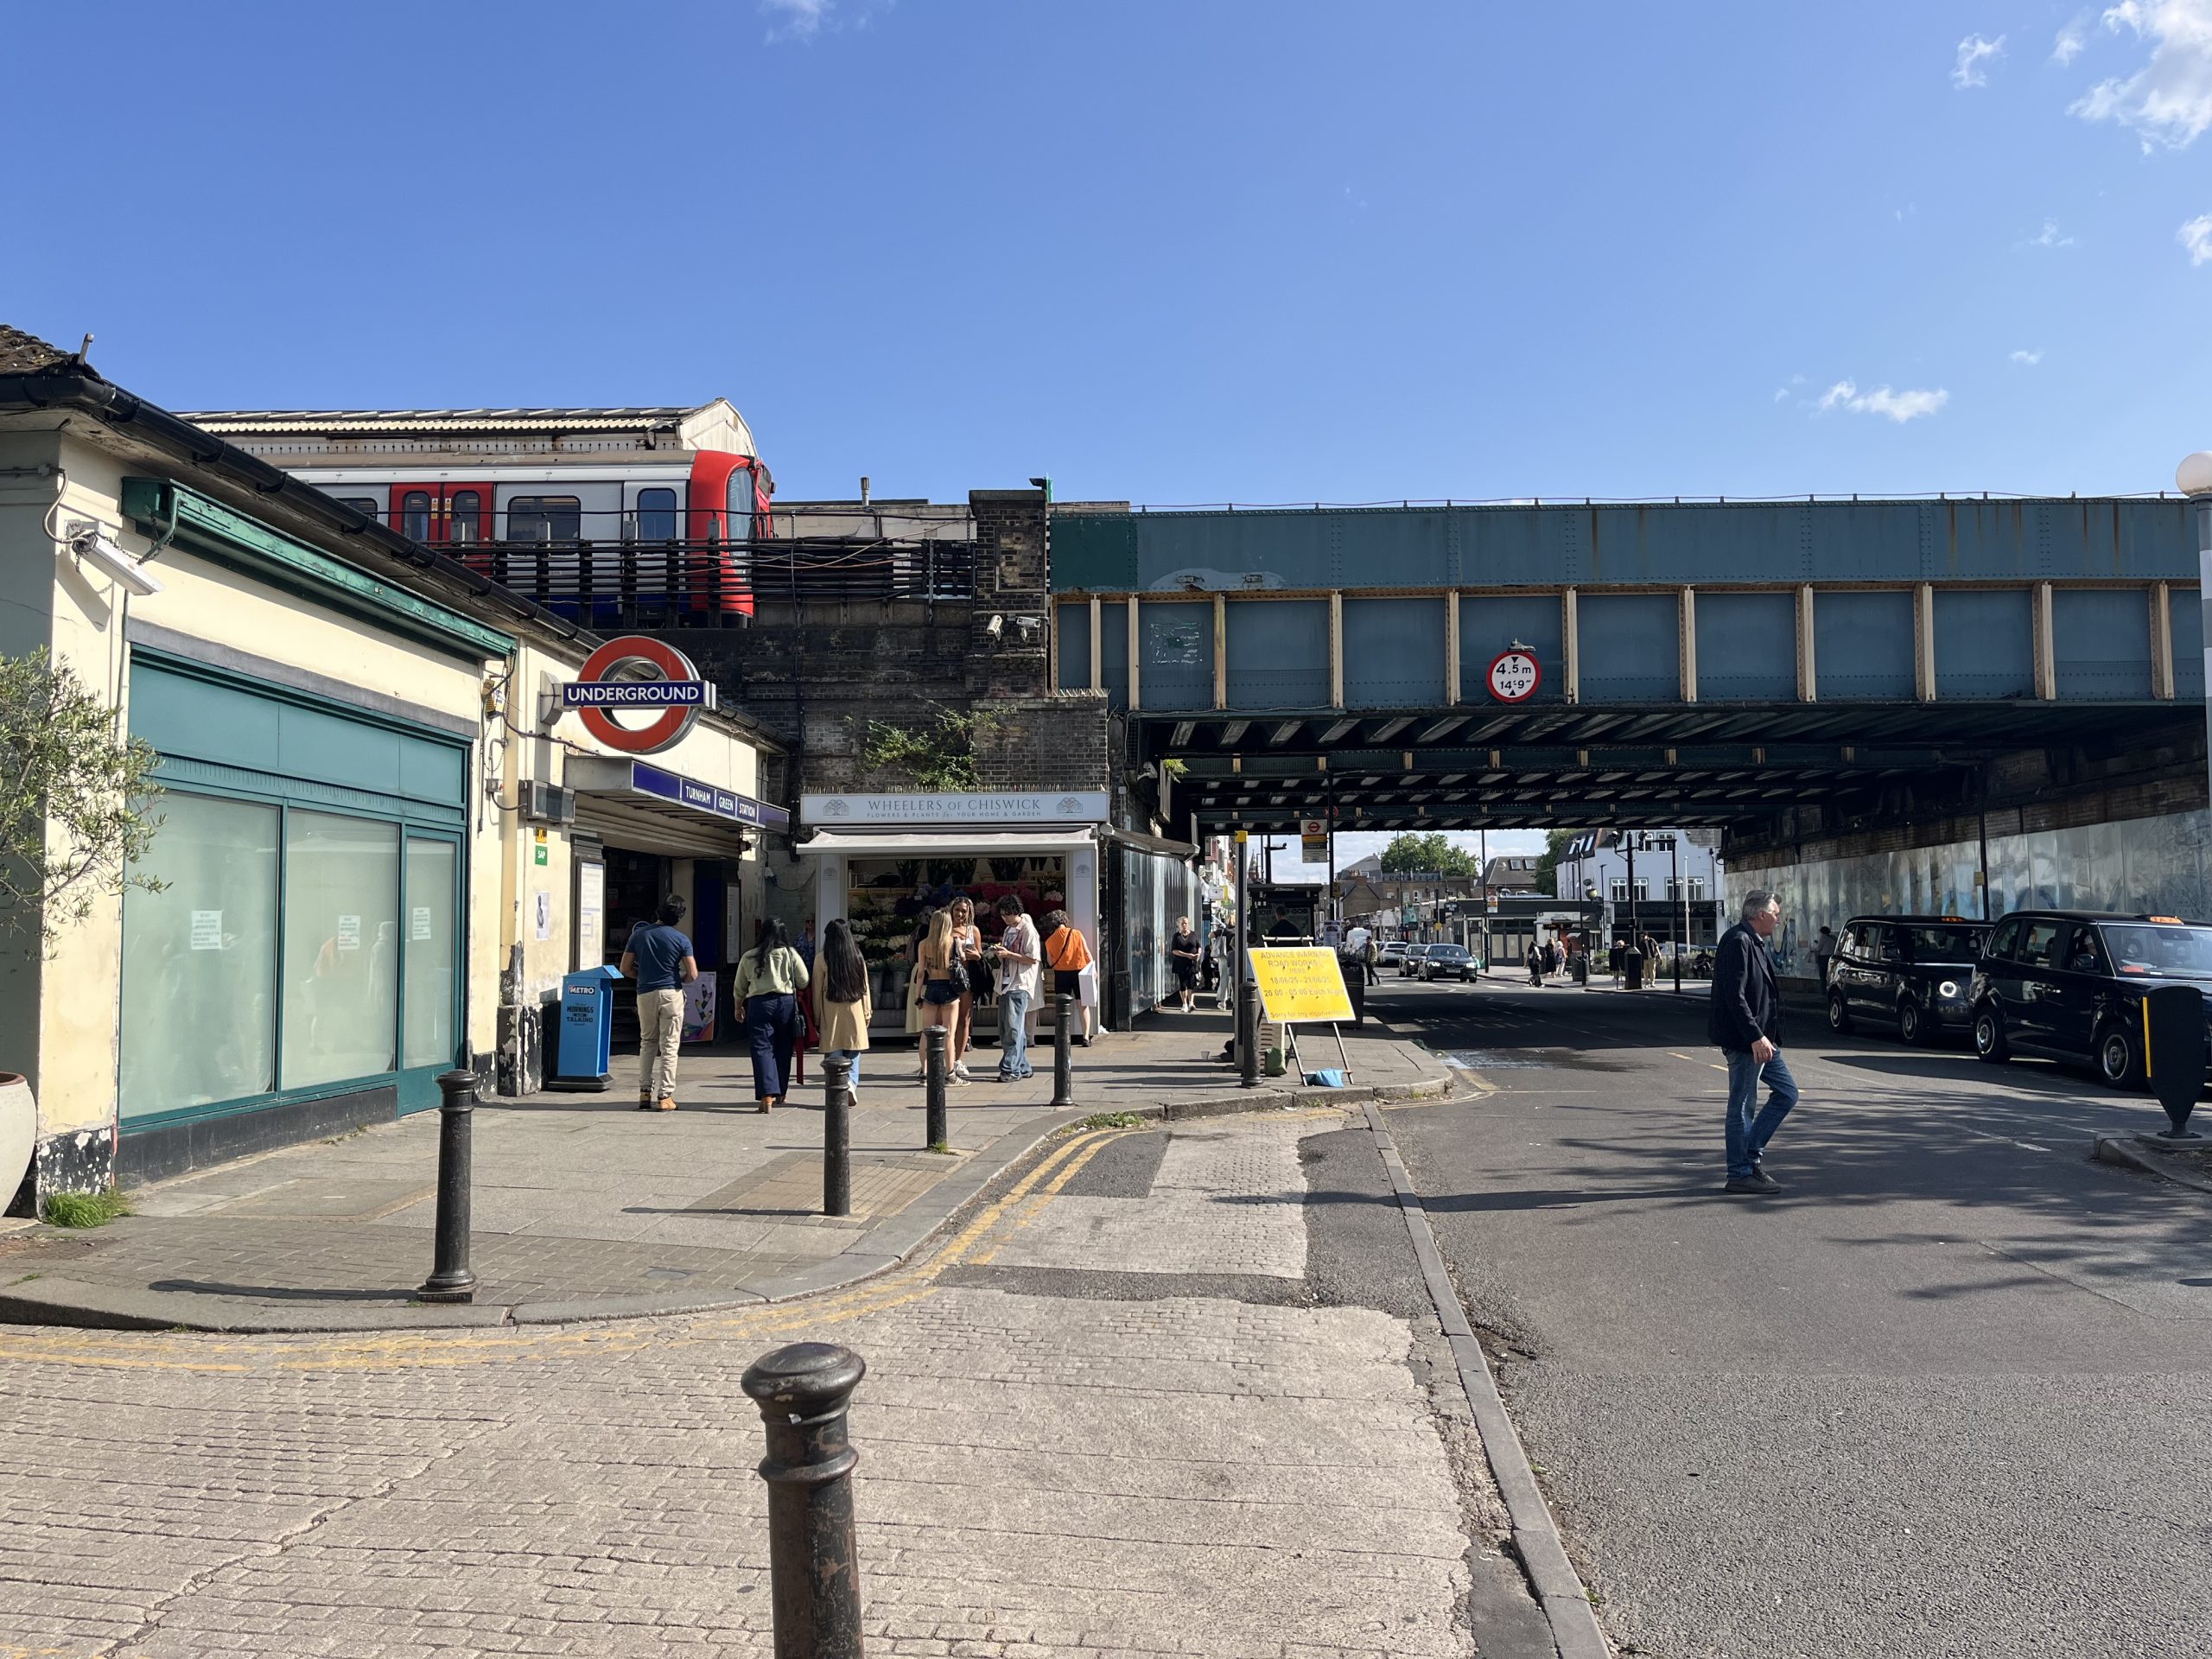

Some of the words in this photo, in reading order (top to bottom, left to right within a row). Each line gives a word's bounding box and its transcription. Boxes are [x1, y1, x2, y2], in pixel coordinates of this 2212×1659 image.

[568, 687, 699, 702] UNDERGROUND
[685, 785, 711, 804] TURNHAM
[718, 796, 734, 811] GREEN
[739, 803, 755, 817] STATION
[868, 800, 942, 810] WHEELERS
[948, 801, 963, 810] OF
[968, 798, 1042, 810] CHISWICK
[537, 850, 546, 859] SAP
[1297, 950, 1330, 958] WARNING
